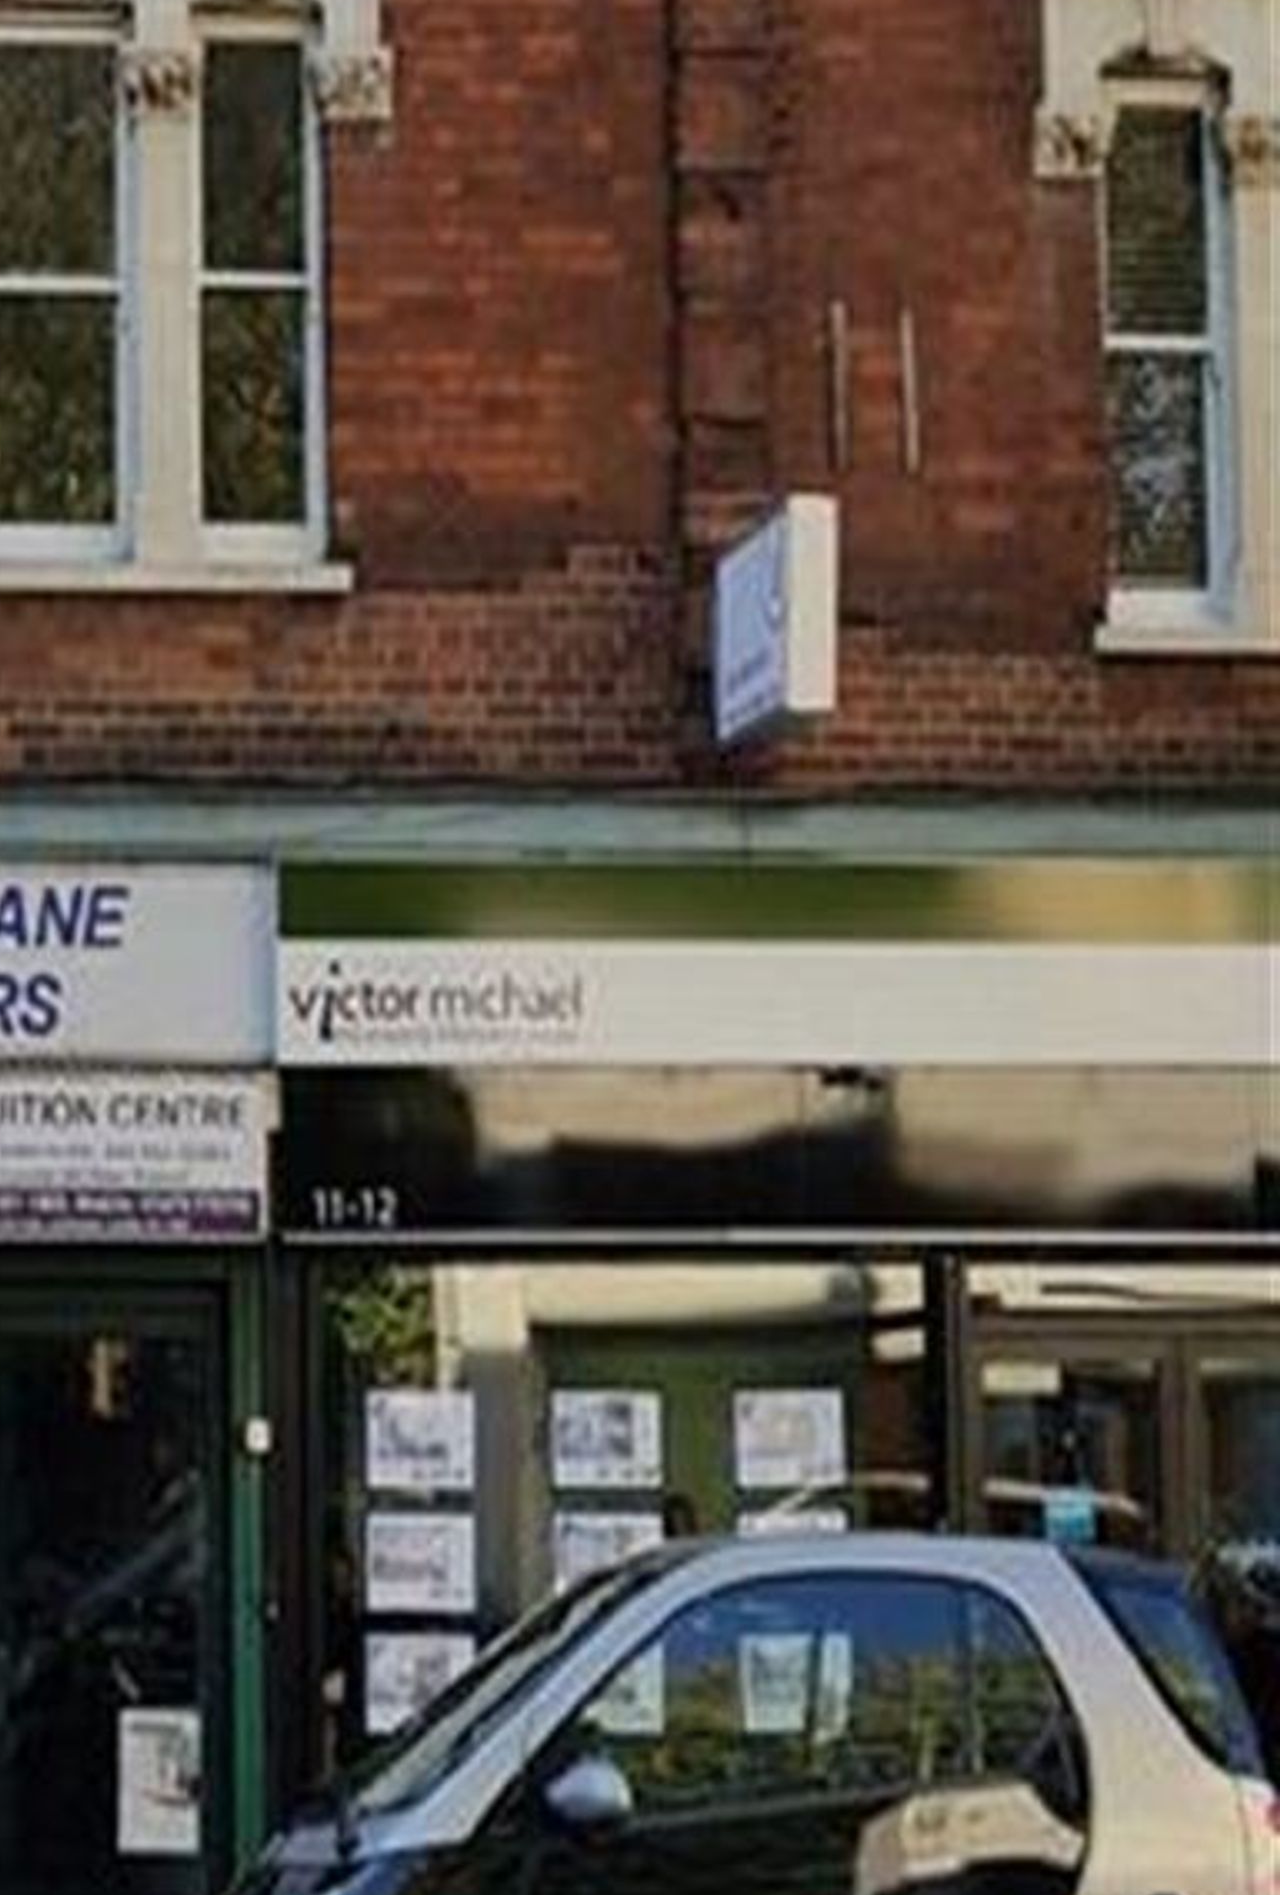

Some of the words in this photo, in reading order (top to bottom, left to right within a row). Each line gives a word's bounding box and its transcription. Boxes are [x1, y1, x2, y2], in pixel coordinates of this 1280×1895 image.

[289, 959, 420, 1039] victor
[430, 972, 583, 1022] michael
[108, 1091, 246, 1126] CENTRE
[312, 1186, 397, 1226] 11-12
